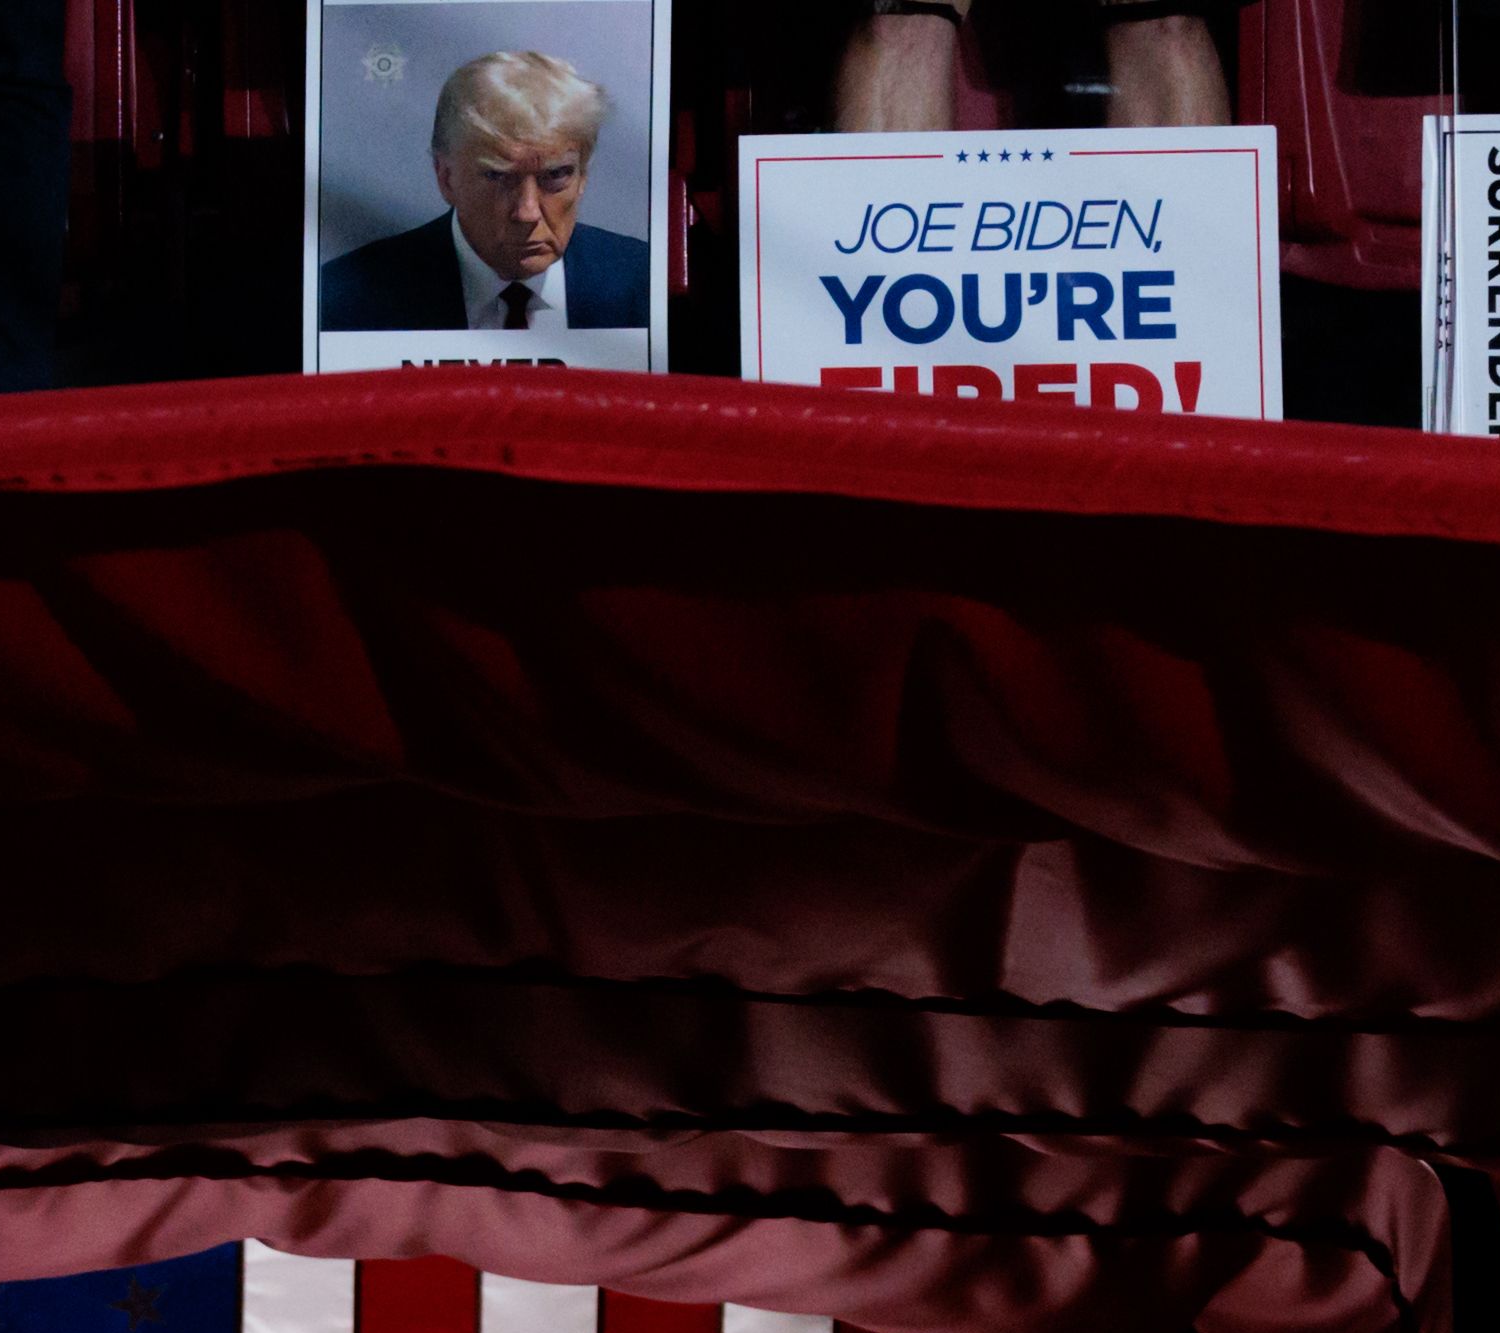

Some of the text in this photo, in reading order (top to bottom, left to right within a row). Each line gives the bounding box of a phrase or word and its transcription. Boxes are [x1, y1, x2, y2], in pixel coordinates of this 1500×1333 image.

[834, 199, 1162, 254] JOE BIDEN,
[819, 270, 1177, 345] YOU’RE
